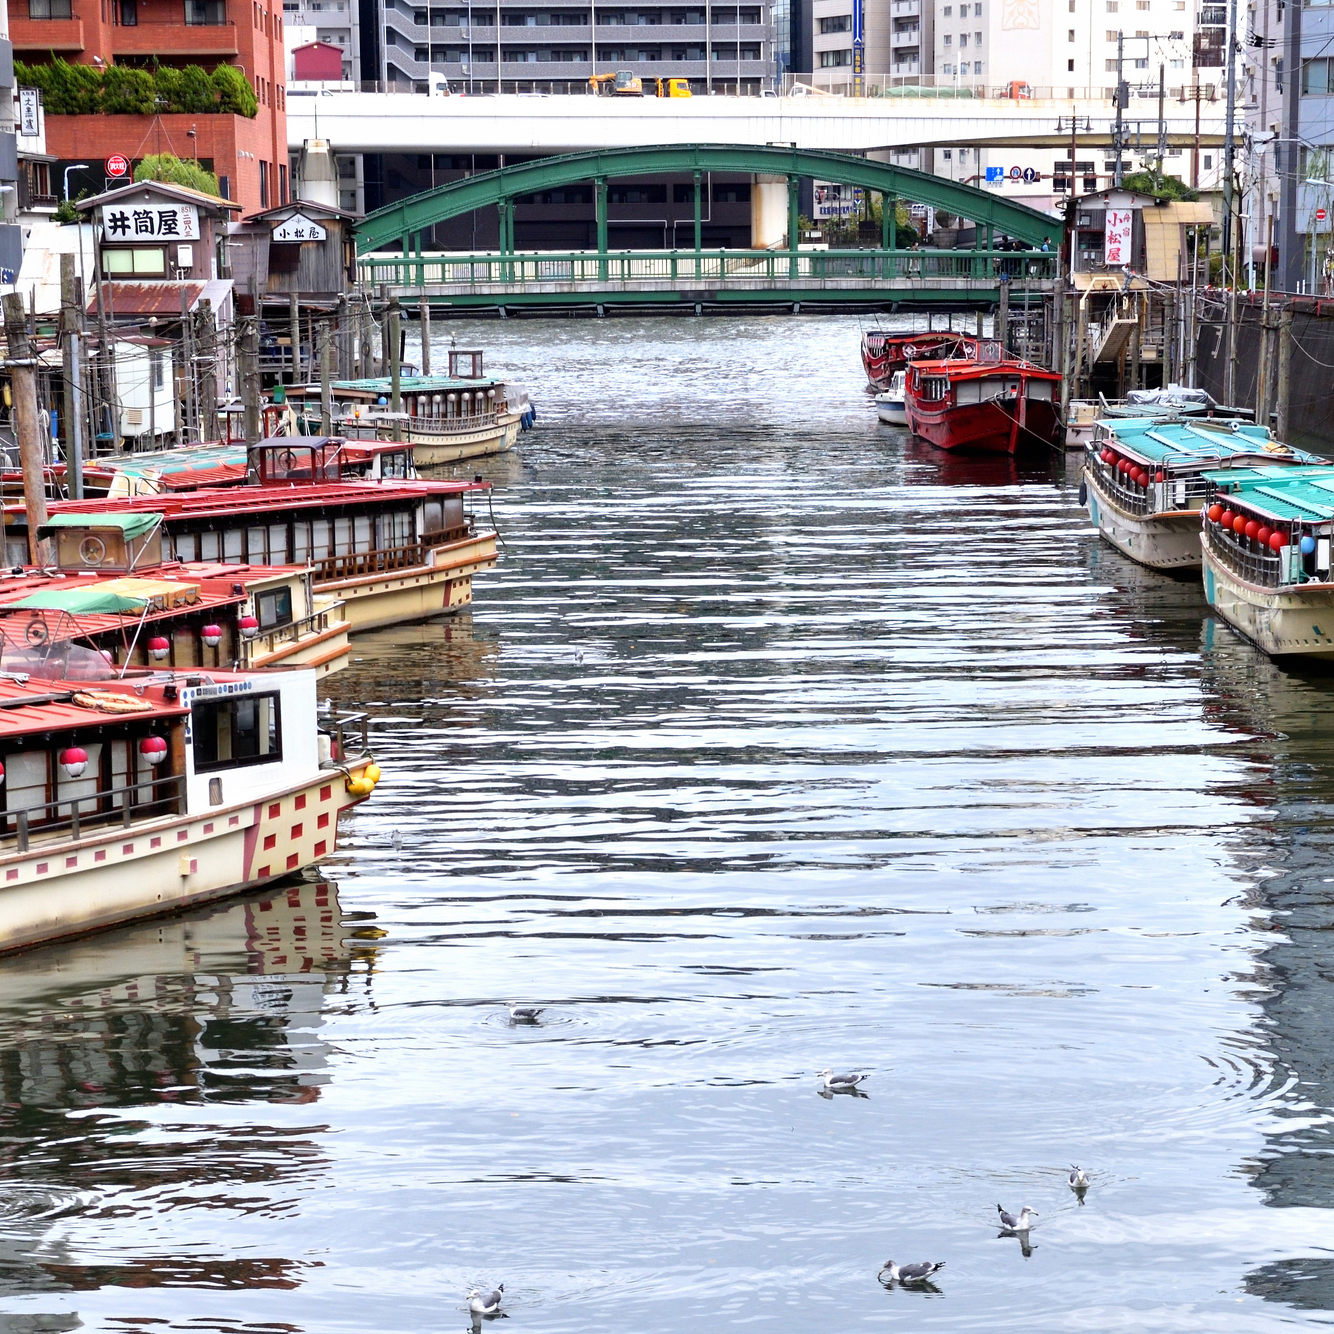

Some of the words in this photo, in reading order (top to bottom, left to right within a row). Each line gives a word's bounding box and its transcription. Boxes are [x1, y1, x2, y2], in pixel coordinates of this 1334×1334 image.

[107, 209, 181, 237] 井筒屋
[279, 226, 320, 239] 小松屋
[1106, 212, 1123, 262] 小松屋
